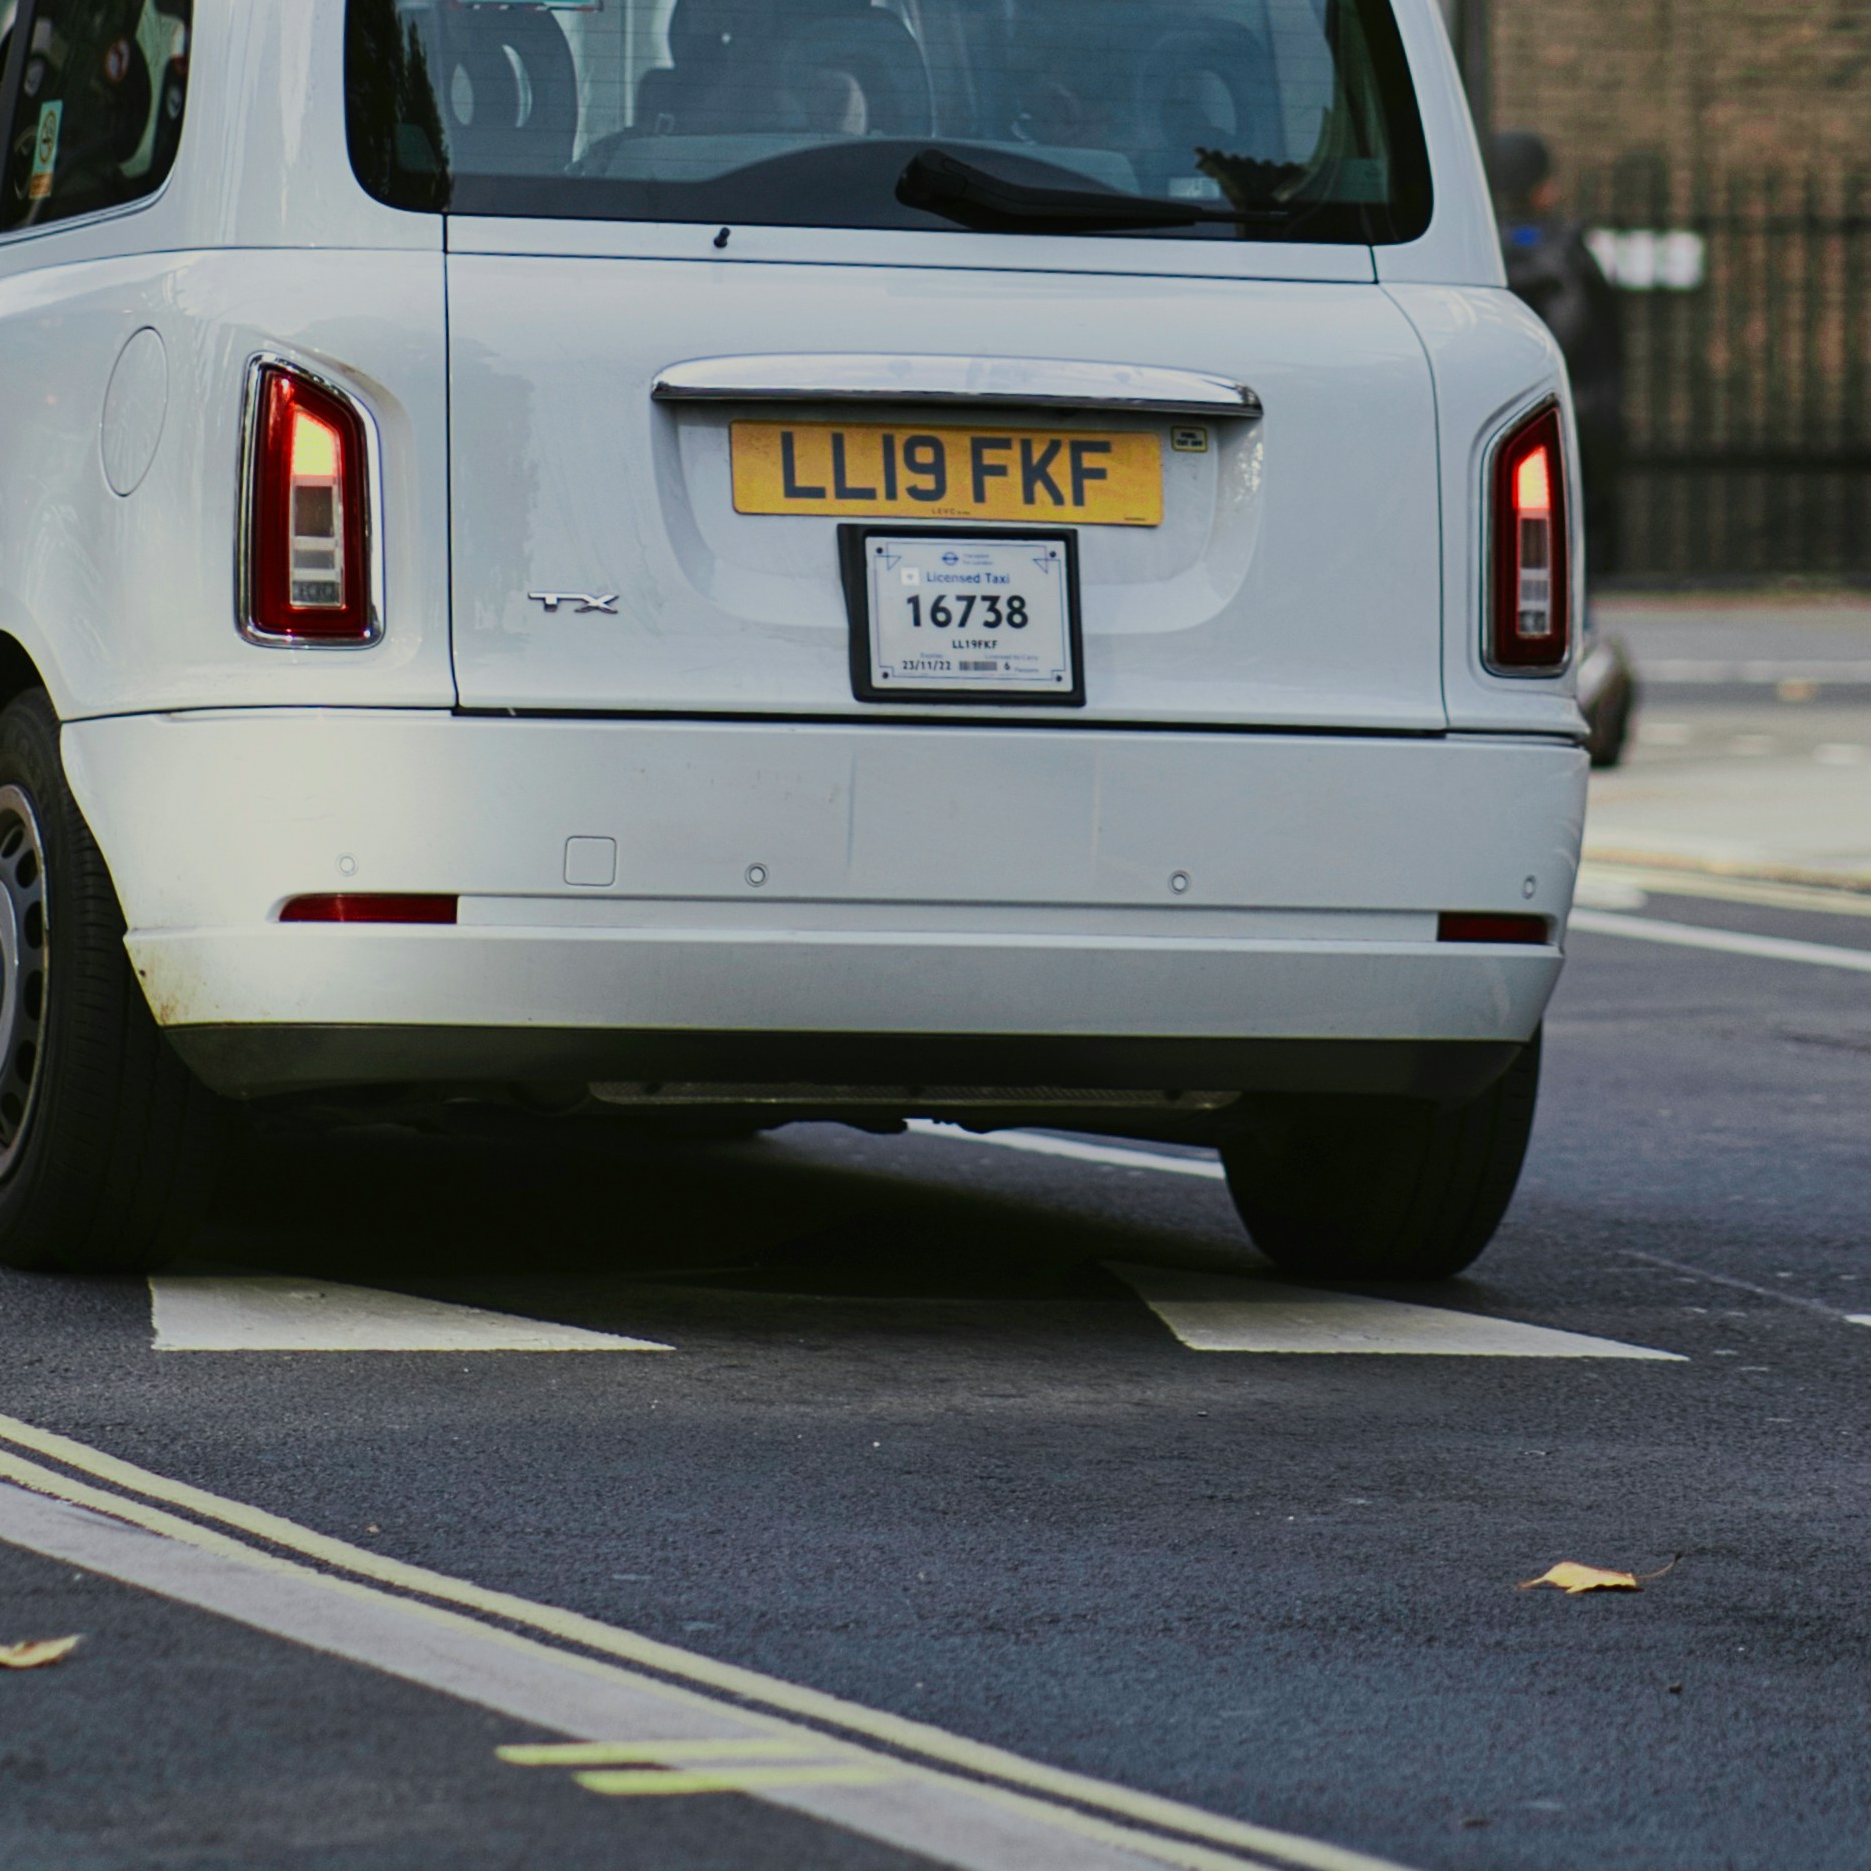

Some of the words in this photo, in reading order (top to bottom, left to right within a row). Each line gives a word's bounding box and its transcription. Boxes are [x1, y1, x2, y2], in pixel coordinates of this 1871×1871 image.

[780, 430, 947, 502] LL19
[970, 436, 1112, 507] FKF
[926, 571, 980, 584] Licensed
[985, 572, 1010, 585] Taxi
[527, 591, 620, 615] TX
[906, 594, 1029, 629] 16738
[952, 639, 998, 650] LL19FKF
[902, 660, 952, 671] 23/11/22
